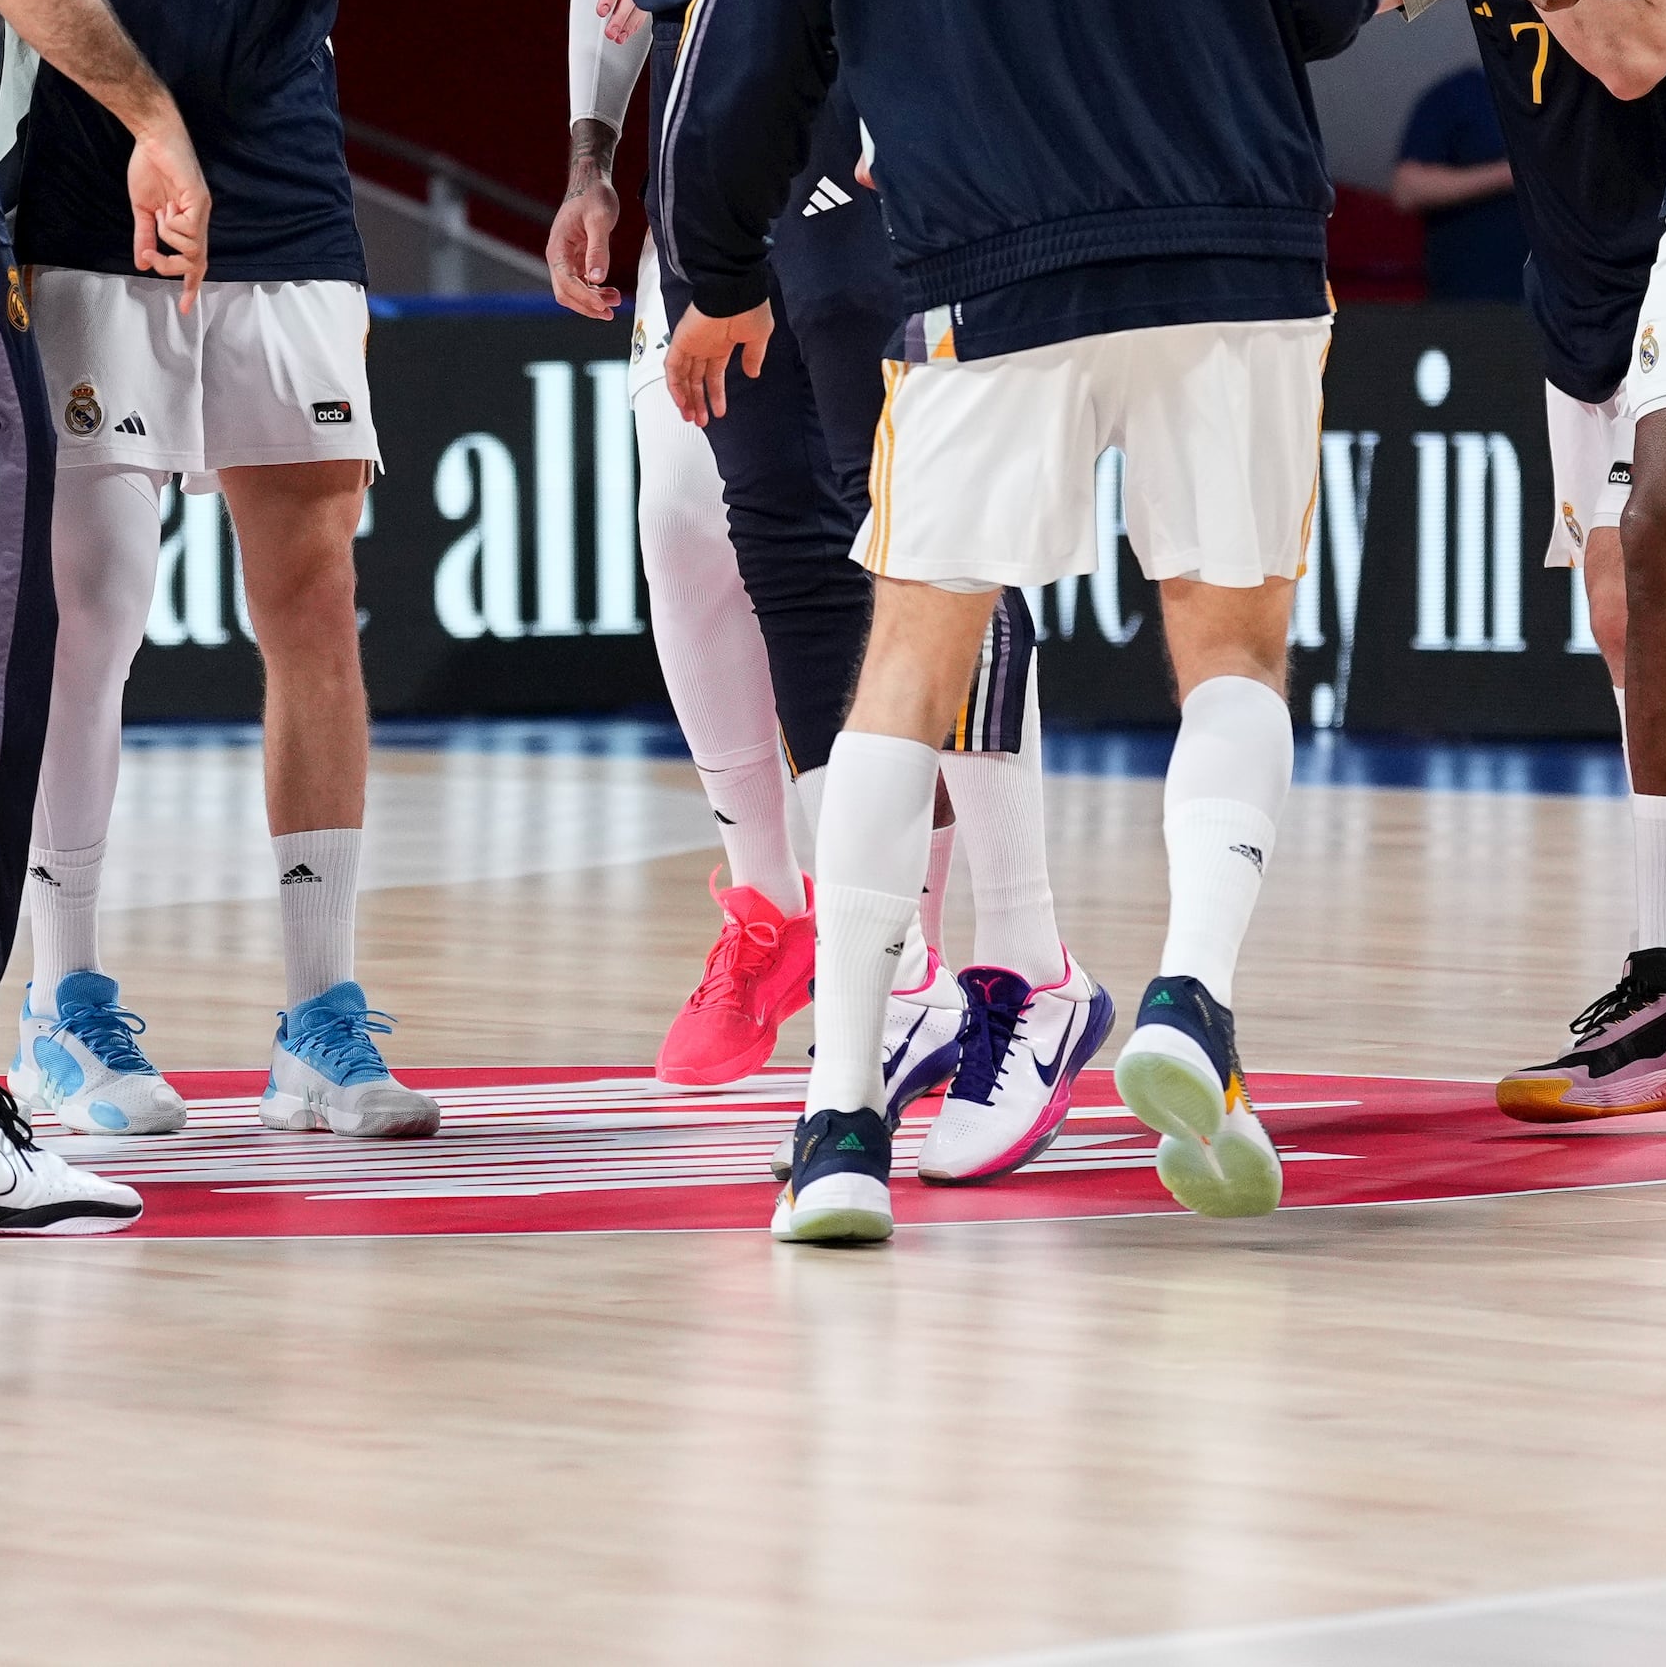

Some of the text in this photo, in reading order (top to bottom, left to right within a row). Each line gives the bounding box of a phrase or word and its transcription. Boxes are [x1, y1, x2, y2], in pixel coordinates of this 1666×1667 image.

[1509, 20, 1550, 106] 7
[318, 408, 345, 422] acb
[1610, 470, 1631, 483] acb
[434, 360, 645, 640] all
[1413, 348, 1529, 652] in
[280, 874, 323, 885] adidas
